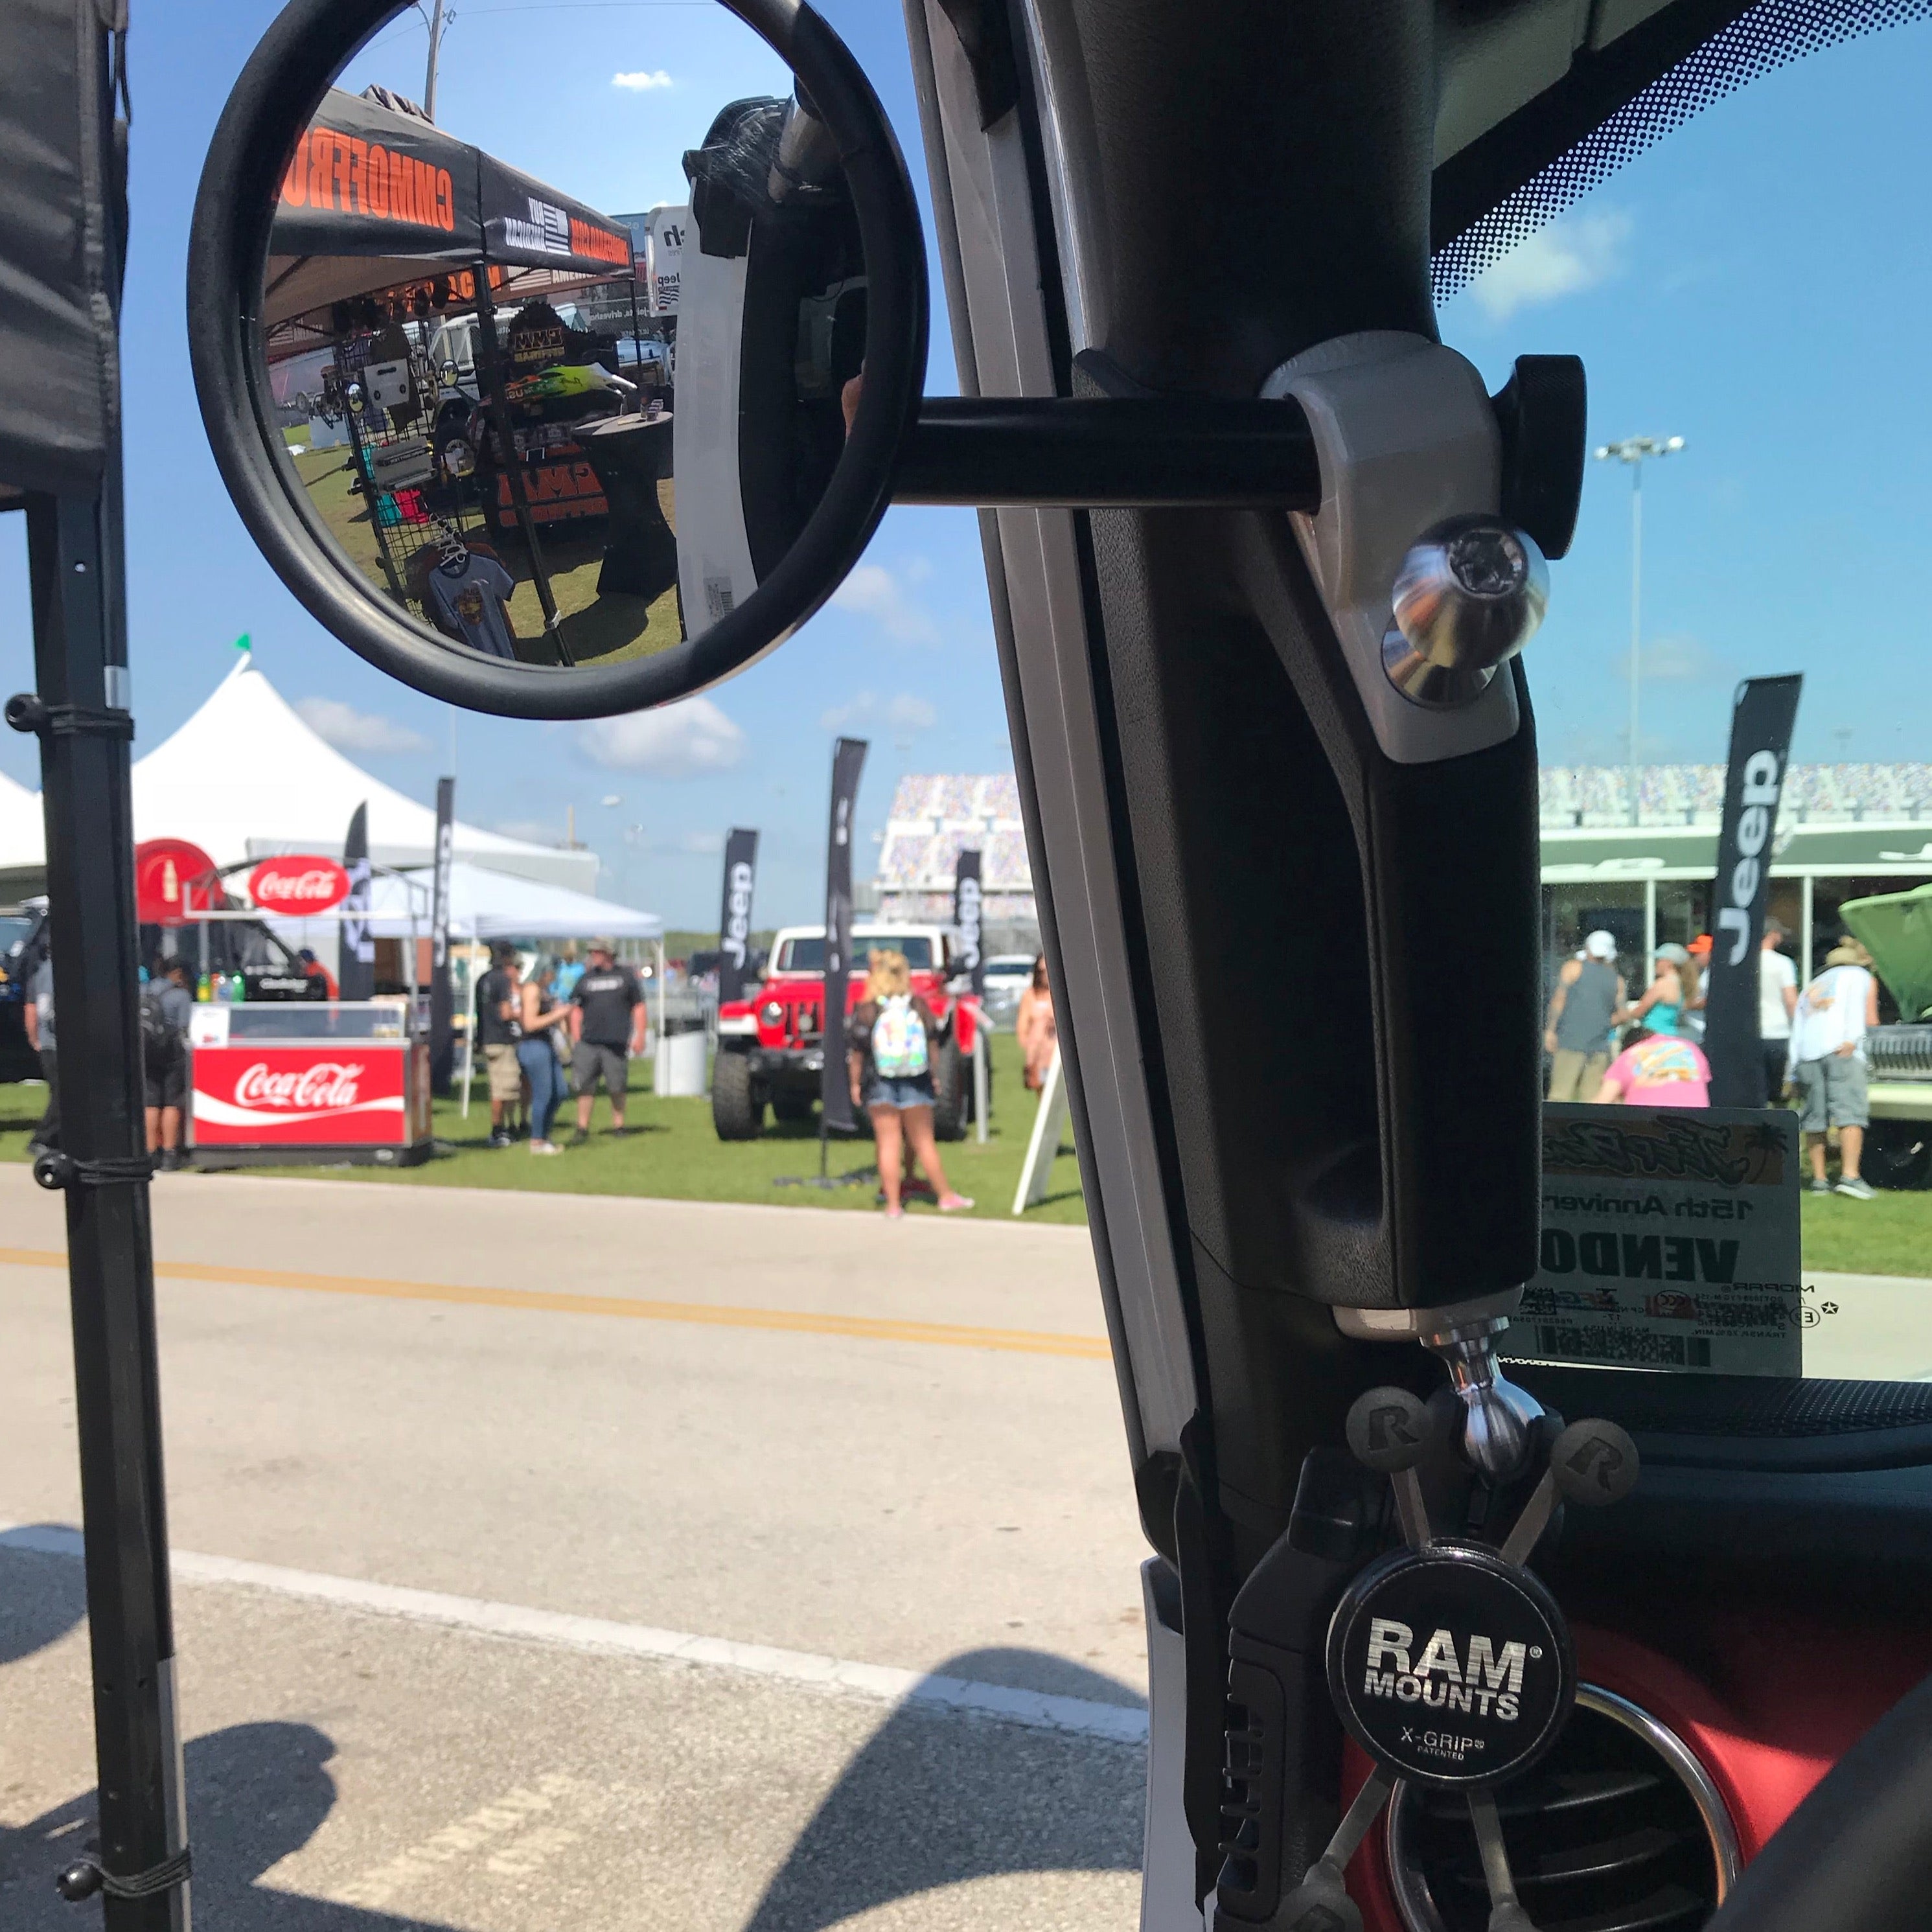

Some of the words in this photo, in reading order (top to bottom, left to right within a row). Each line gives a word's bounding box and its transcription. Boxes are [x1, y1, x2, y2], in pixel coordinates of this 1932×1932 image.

[1718, 750, 1779, 967] Jeep
[722, 861, 753, 970] Jeep
[958, 877, 982, 970] Jeep
[1368, 1406, 1420, 1452] R
[1565, 1436, 1624, 1493] R
[1366, 1616, 1527, 1694] RAM
[1363, 1668, 1521, 1721] MOUNTS
[1417, 1745, 1466, 1761] PATENTED
